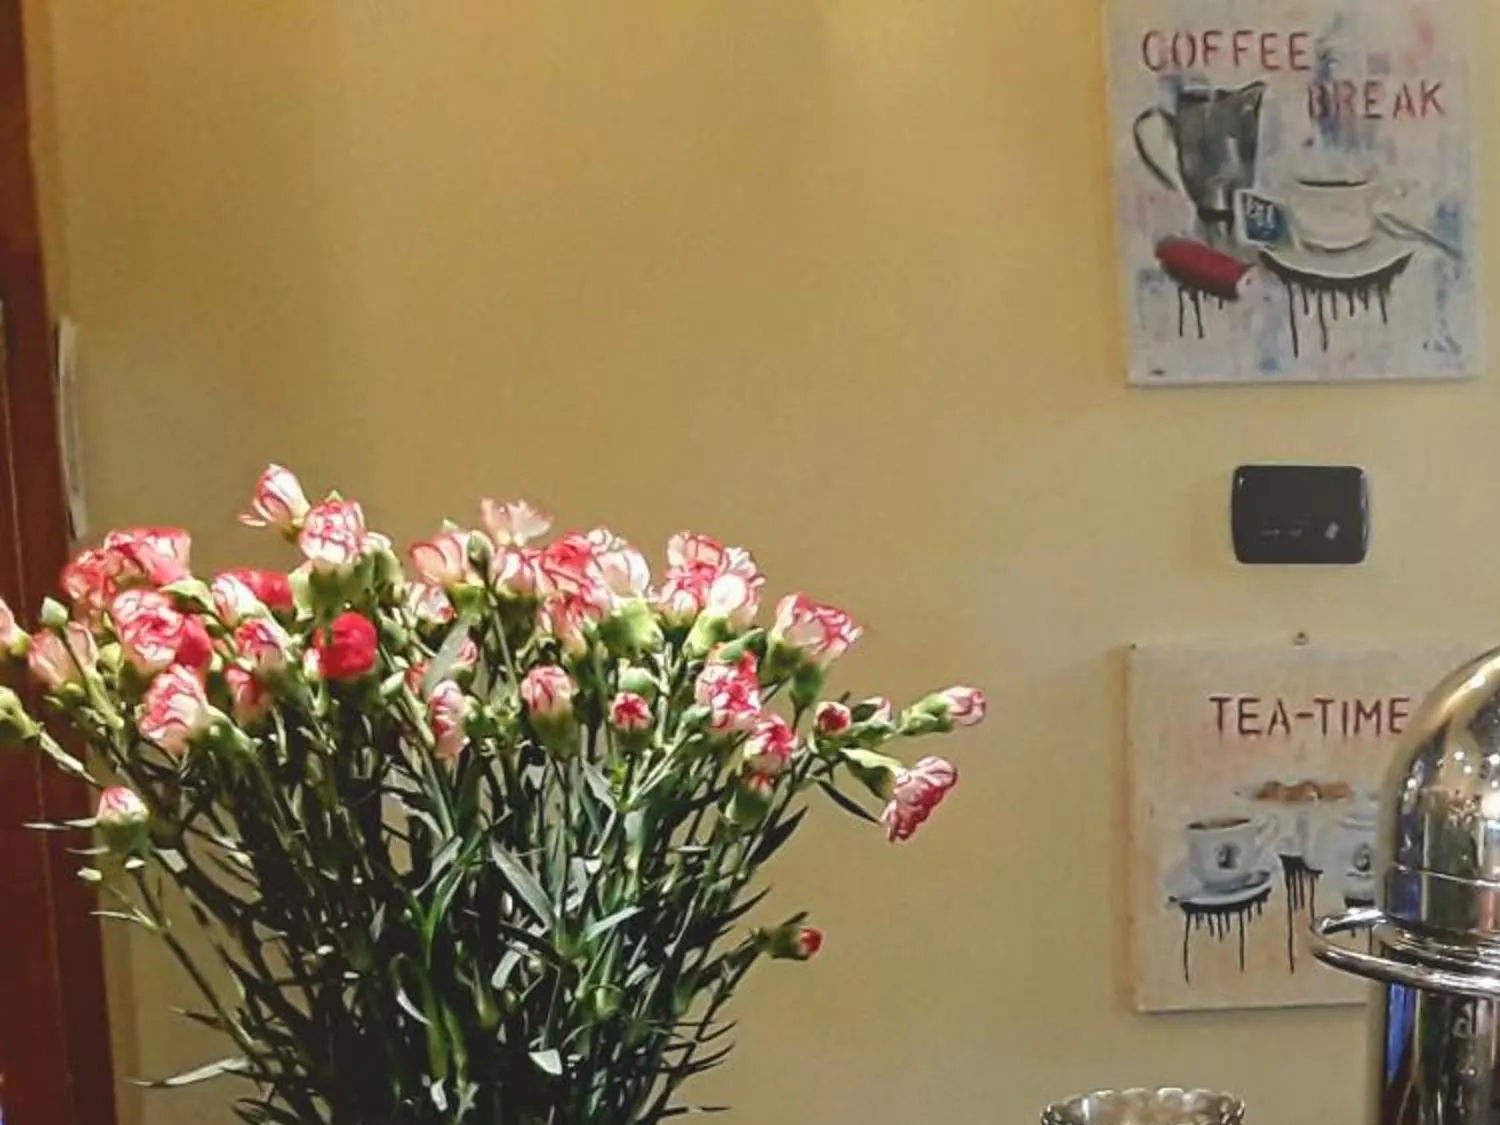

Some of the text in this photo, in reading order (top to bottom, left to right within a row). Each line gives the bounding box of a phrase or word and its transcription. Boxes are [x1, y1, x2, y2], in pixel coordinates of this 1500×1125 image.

[1141, 29, 1312, 72] COFFEE
[1306, 80, 1447, 120] BREAK
[1209, 696, 1412, 737] TEA-TIME
